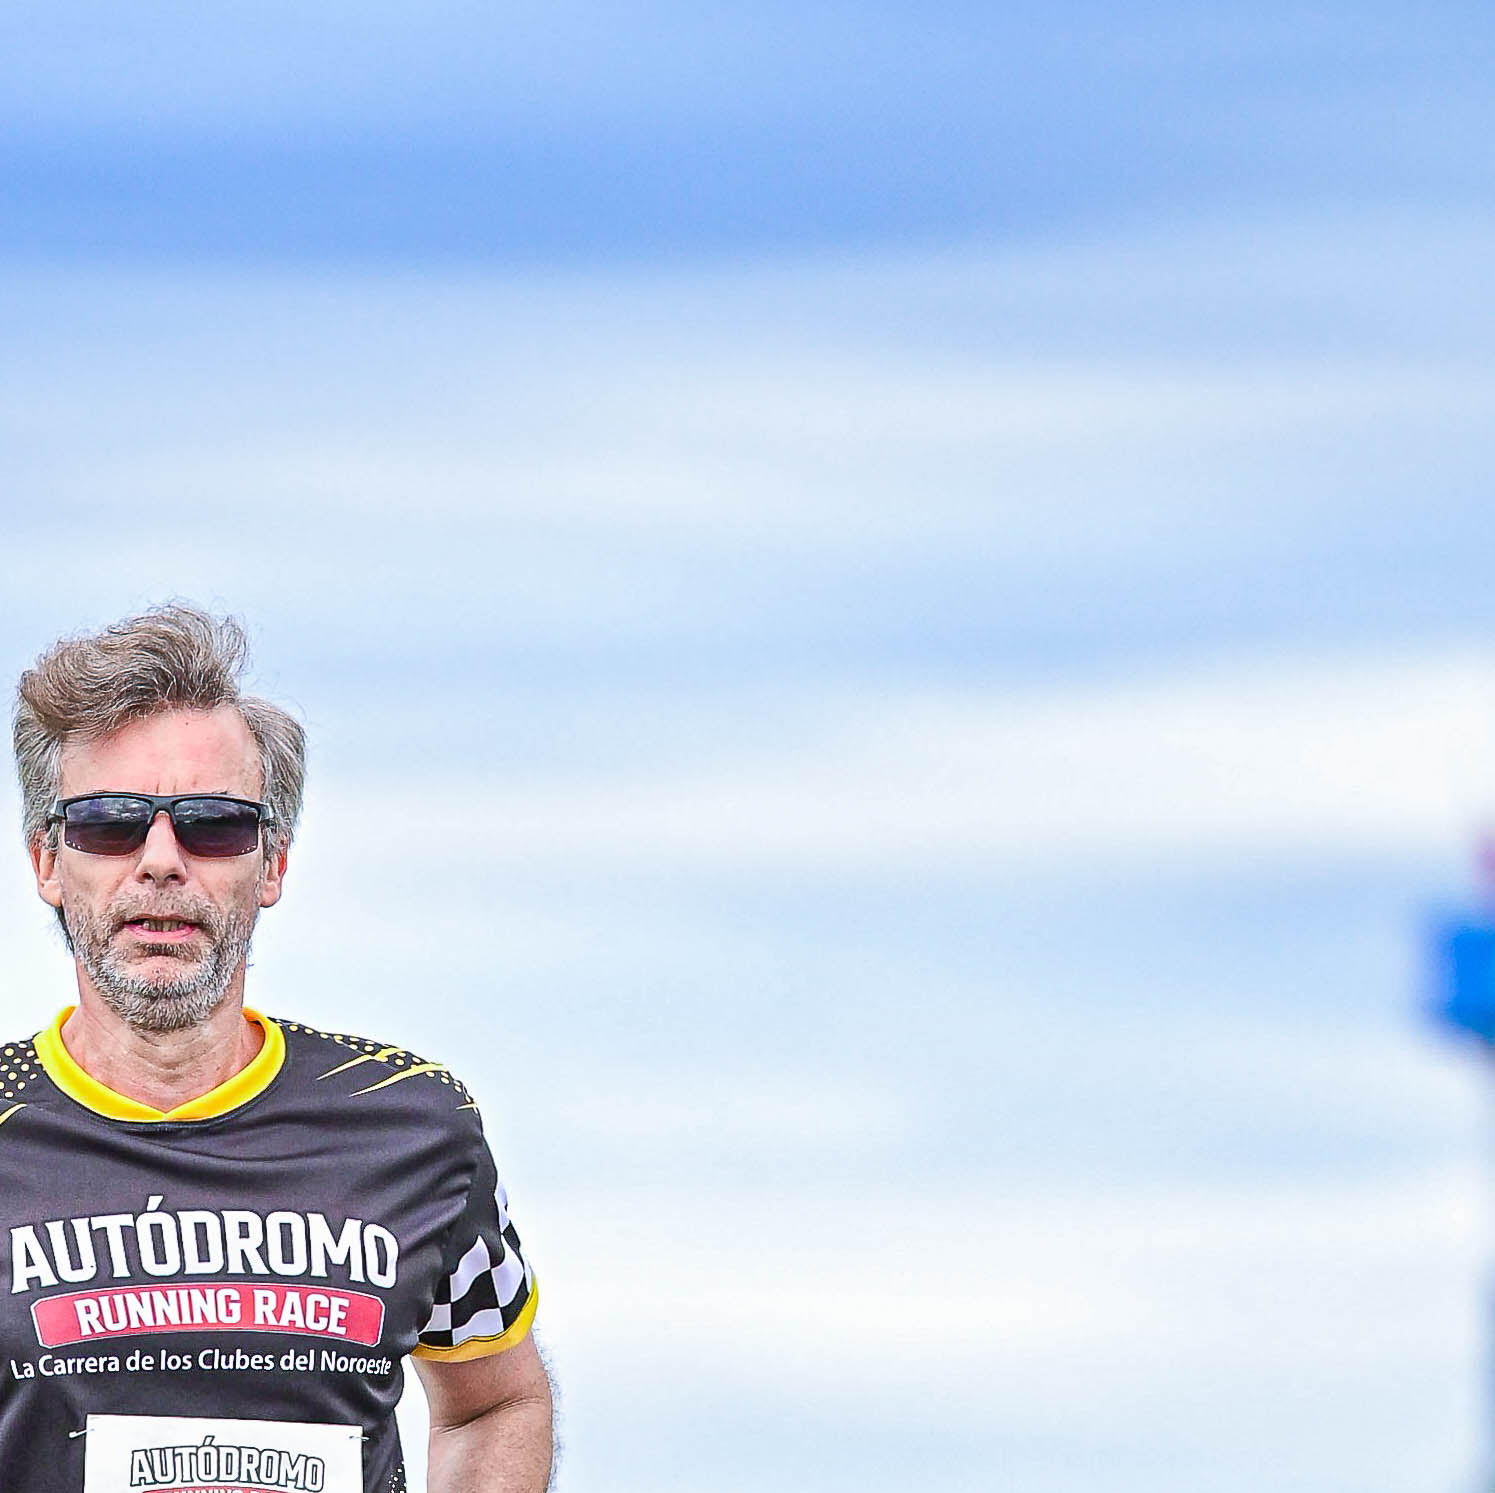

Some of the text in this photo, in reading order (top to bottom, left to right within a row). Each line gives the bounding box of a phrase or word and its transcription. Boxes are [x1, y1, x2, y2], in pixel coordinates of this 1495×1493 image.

[10, 1195, 400, 1295] AUTÓDROMO
[73, 1288, 351, 1337] RUNNING RACE
[10, 1349, 392, 1380] La Carrera de los Clubes del Noroeste
[130, 1435, 325, 1493] AUTÓDROMO
